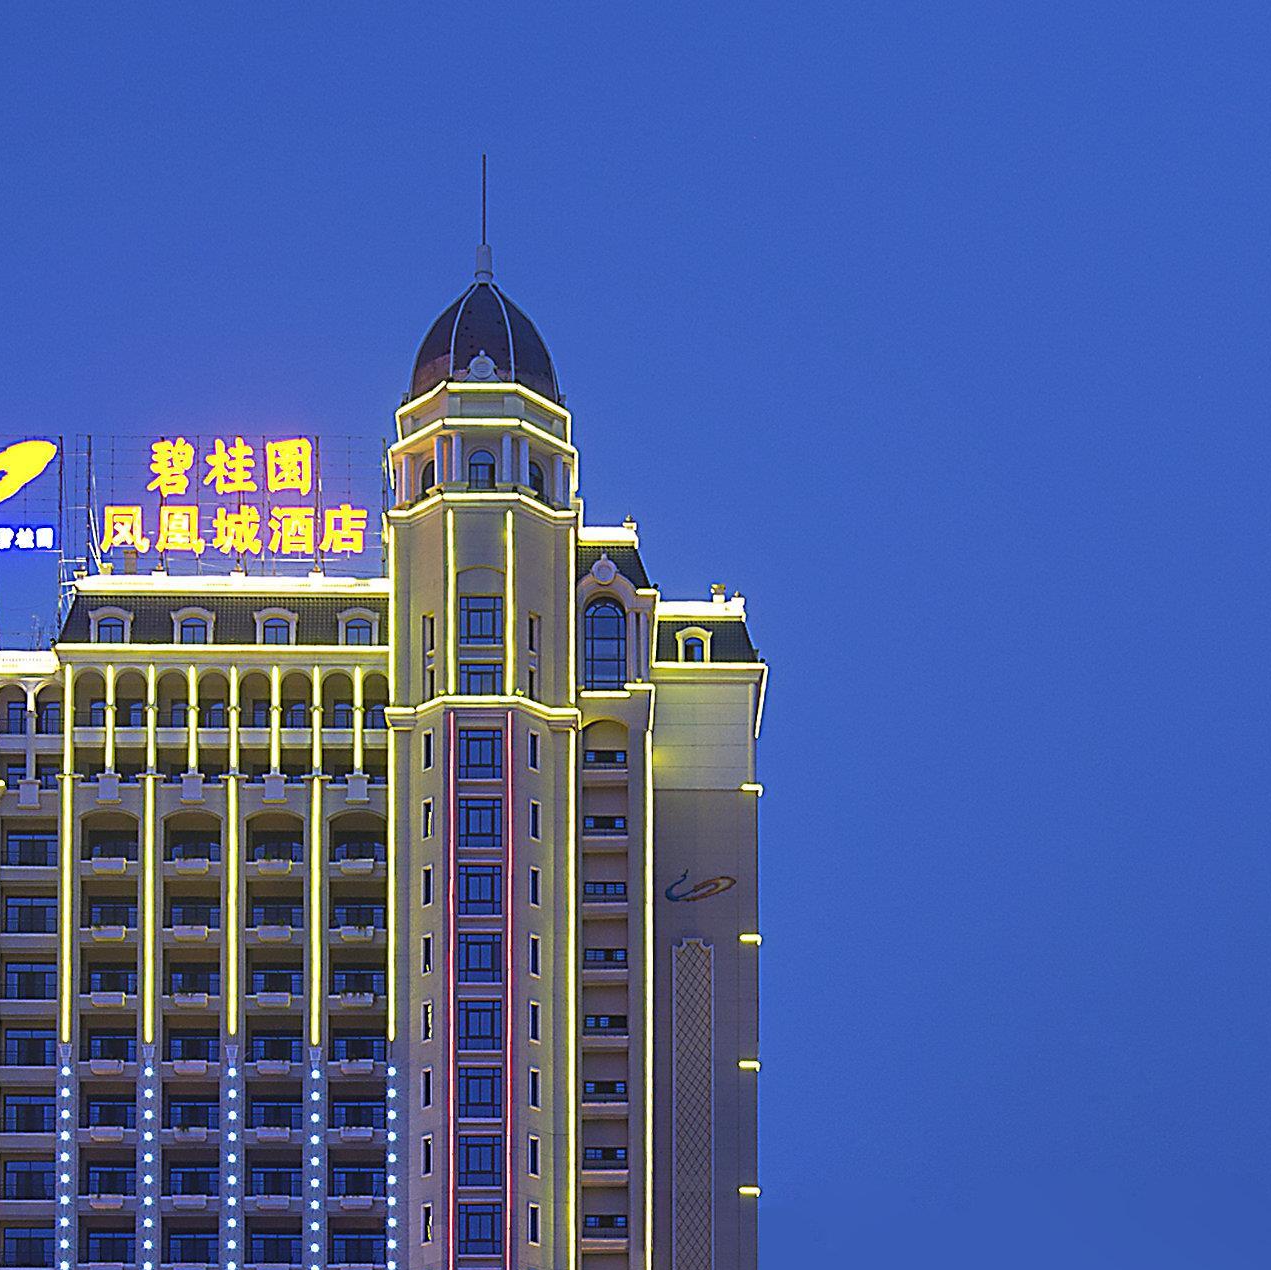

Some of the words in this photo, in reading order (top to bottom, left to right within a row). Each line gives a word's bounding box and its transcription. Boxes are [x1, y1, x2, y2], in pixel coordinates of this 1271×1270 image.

[100, 504, 368, 554] 凤凰城酒店
